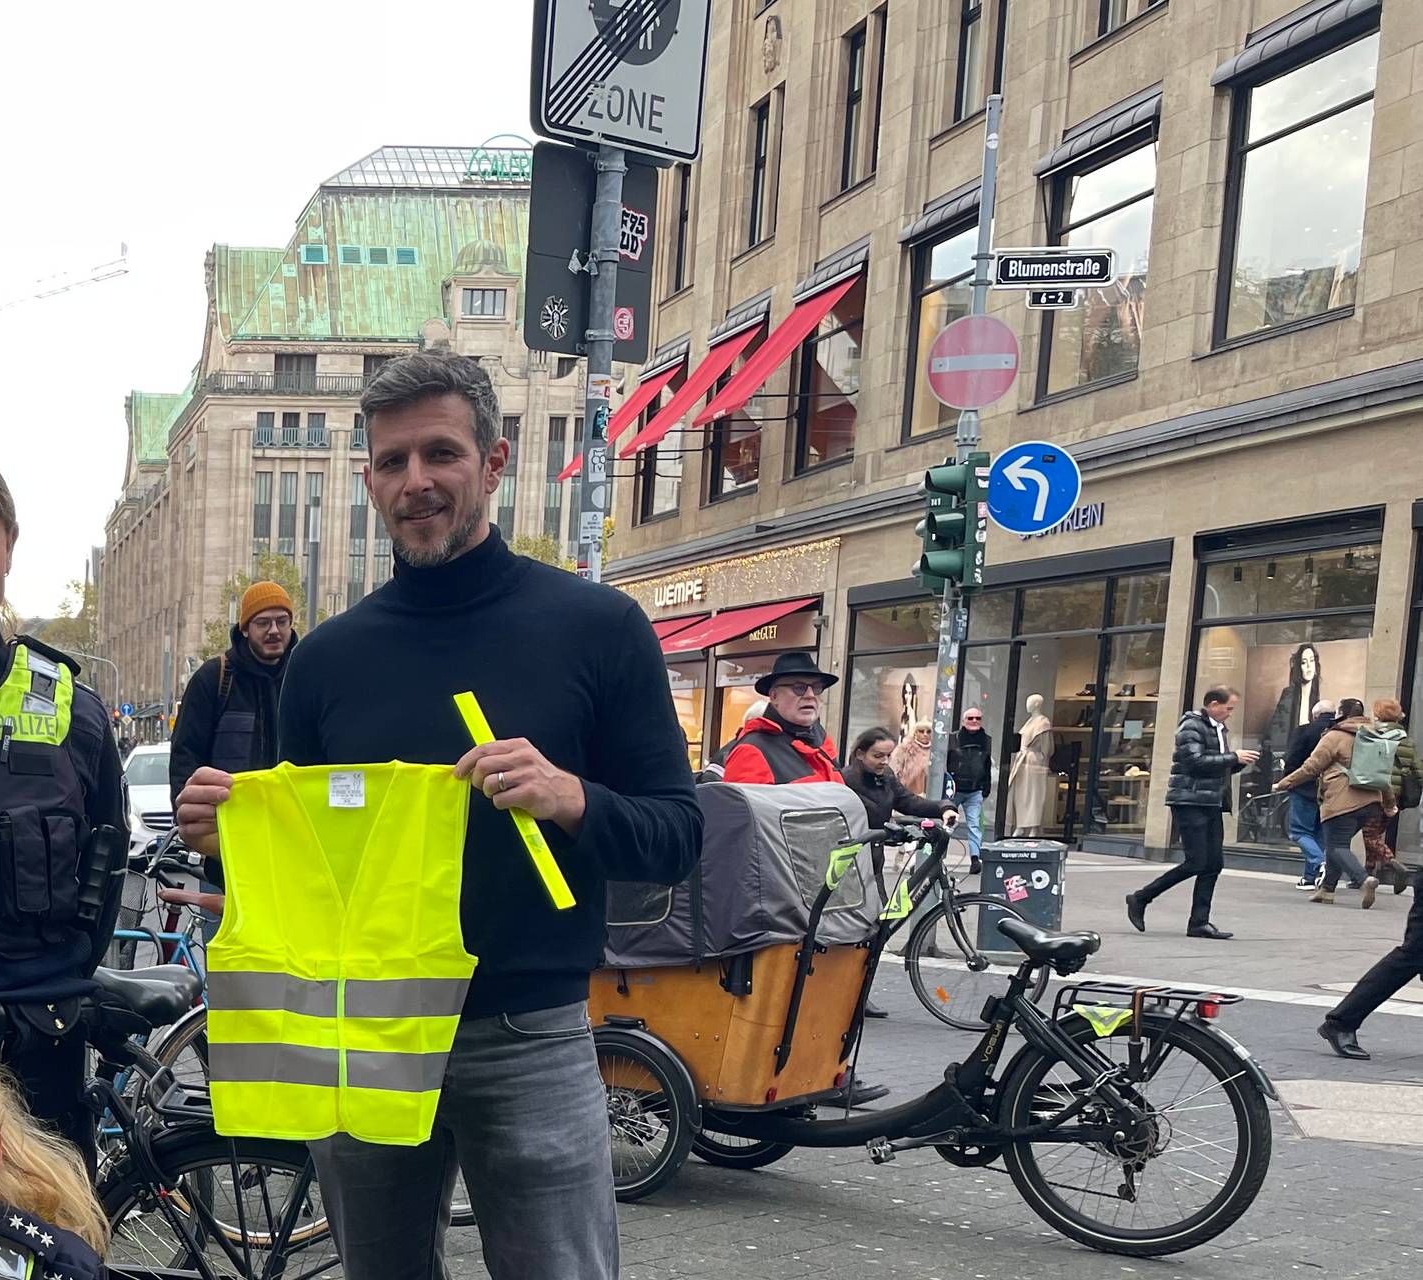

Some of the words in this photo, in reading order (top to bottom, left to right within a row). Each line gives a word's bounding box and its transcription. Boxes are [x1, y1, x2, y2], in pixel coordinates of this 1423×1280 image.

[588, 81, 665, 133] ZONE
[1008, 258, 1100, 277] Blumenstraße
[654, 578, 703, 607] WEMPE
[981, 1023, 1002, 1062] VOGUE
